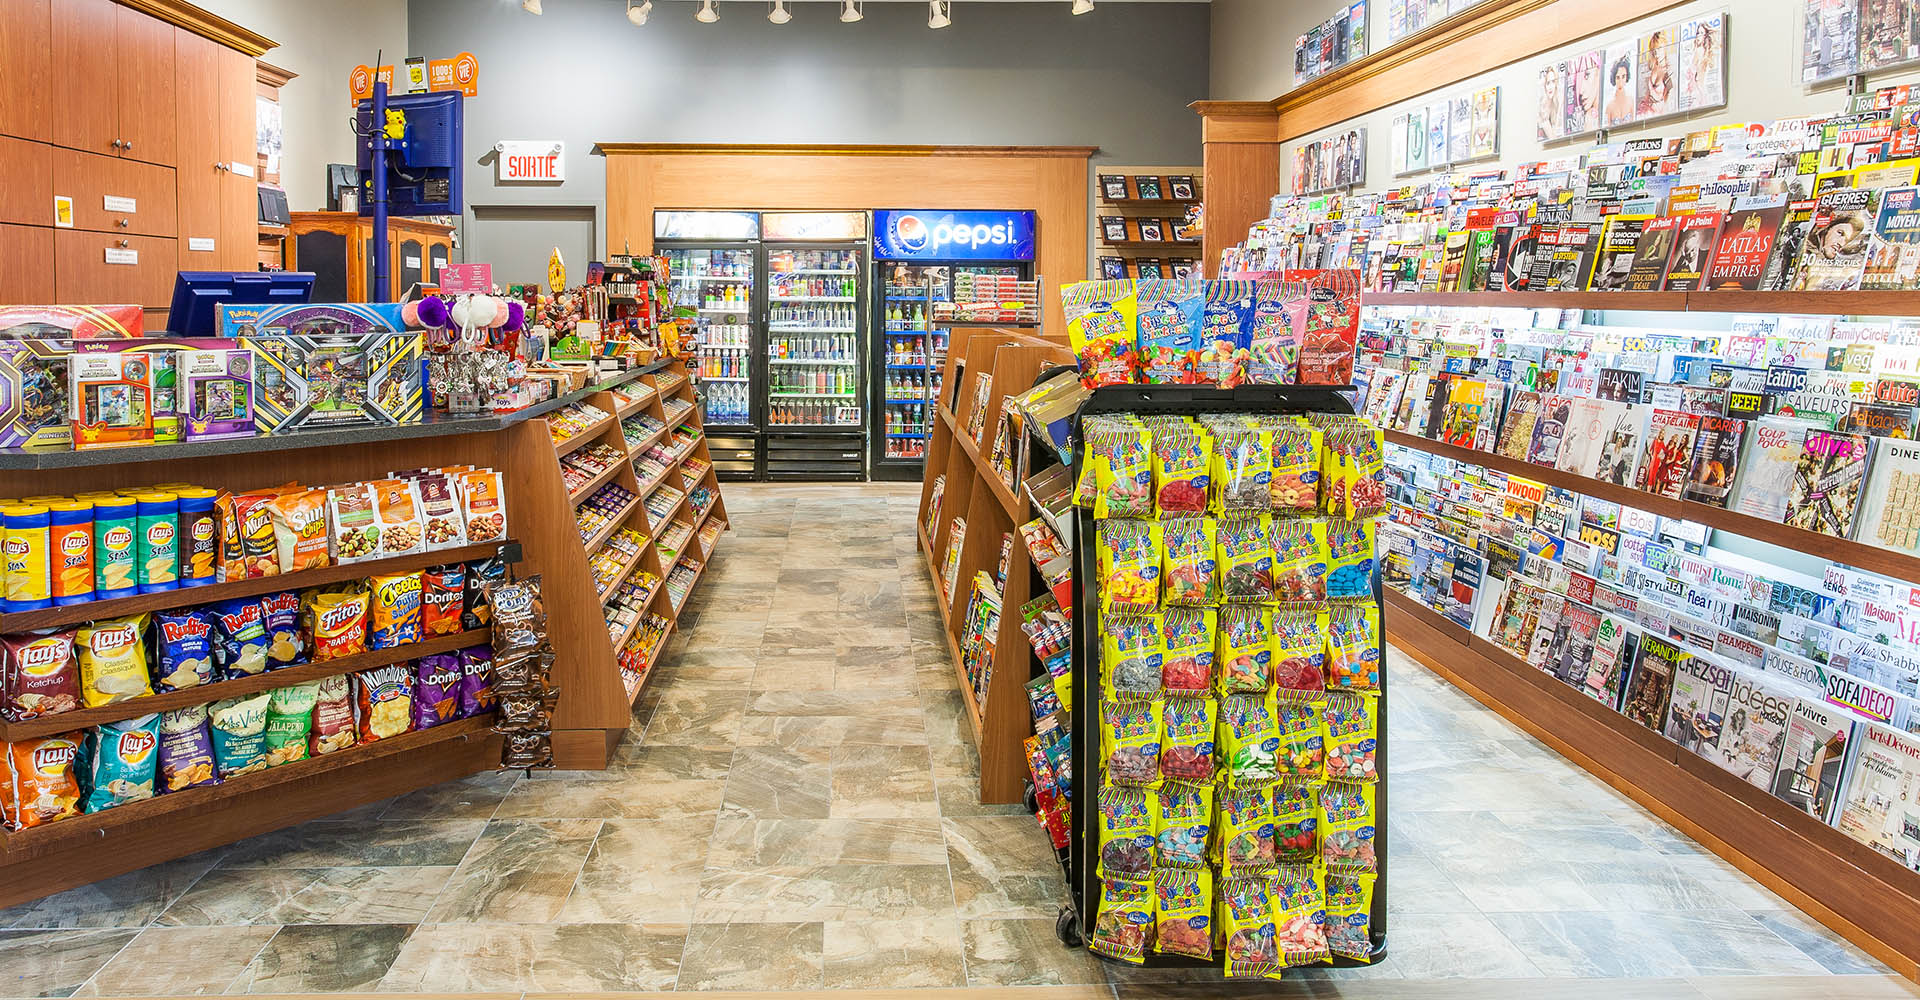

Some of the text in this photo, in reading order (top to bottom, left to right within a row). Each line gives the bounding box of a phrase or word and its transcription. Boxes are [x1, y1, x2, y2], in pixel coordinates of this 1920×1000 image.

[508, 155, 558, 178] SORTIE
[1631, 179, 1646, 190] CR
[1821, 191, 1870, 206] GUERRES
[1696, 216, 1713, 226] Point
[932, 221, 1013, 250] pepsi
[1719, 235, 1771, 254] L'ATLAS
[1733, 255, 1747, 264] DES
[1712, 264, 1762, 278] EMPIRES
[1141, 310, 1187, 330] Sweet
[1766, 366, 1807, 392] Eating
[1730, 393, 1763, 412] BEEF!
[1788, 394, 1850, 416] SAVEURS
[1702, 416, 1745, 434] RICARDO
[1758, 426, 1786, 441] COUP
[1806, 431, 1852, 458] olive
[291, 504, 324, 532] Sun
[302, 518, 325, 538] Chips
[1580, 526, 1617, 552] HOSS
[379, 576, 422, 607] Cheetos
[424, 592, 464, 605] Doritos
[321, 602, 362, 631] Fritos
[1864, 602, 1896, 624] Maison
[1693, 624, 1717, 639] DESIGN
[1641, 636, 1680, 664] VERANDA
[1767, 653, 1794, 675] HOUSE
[27, 675, 64, 689] Ketchup
[362, 664, 409, 691] Munchos
[1827, 674, 1895, 720] SOFADECO
[267, 719, 305, 733] JALAPEÑO
[1759, 710, 1787, 728] MAISON
